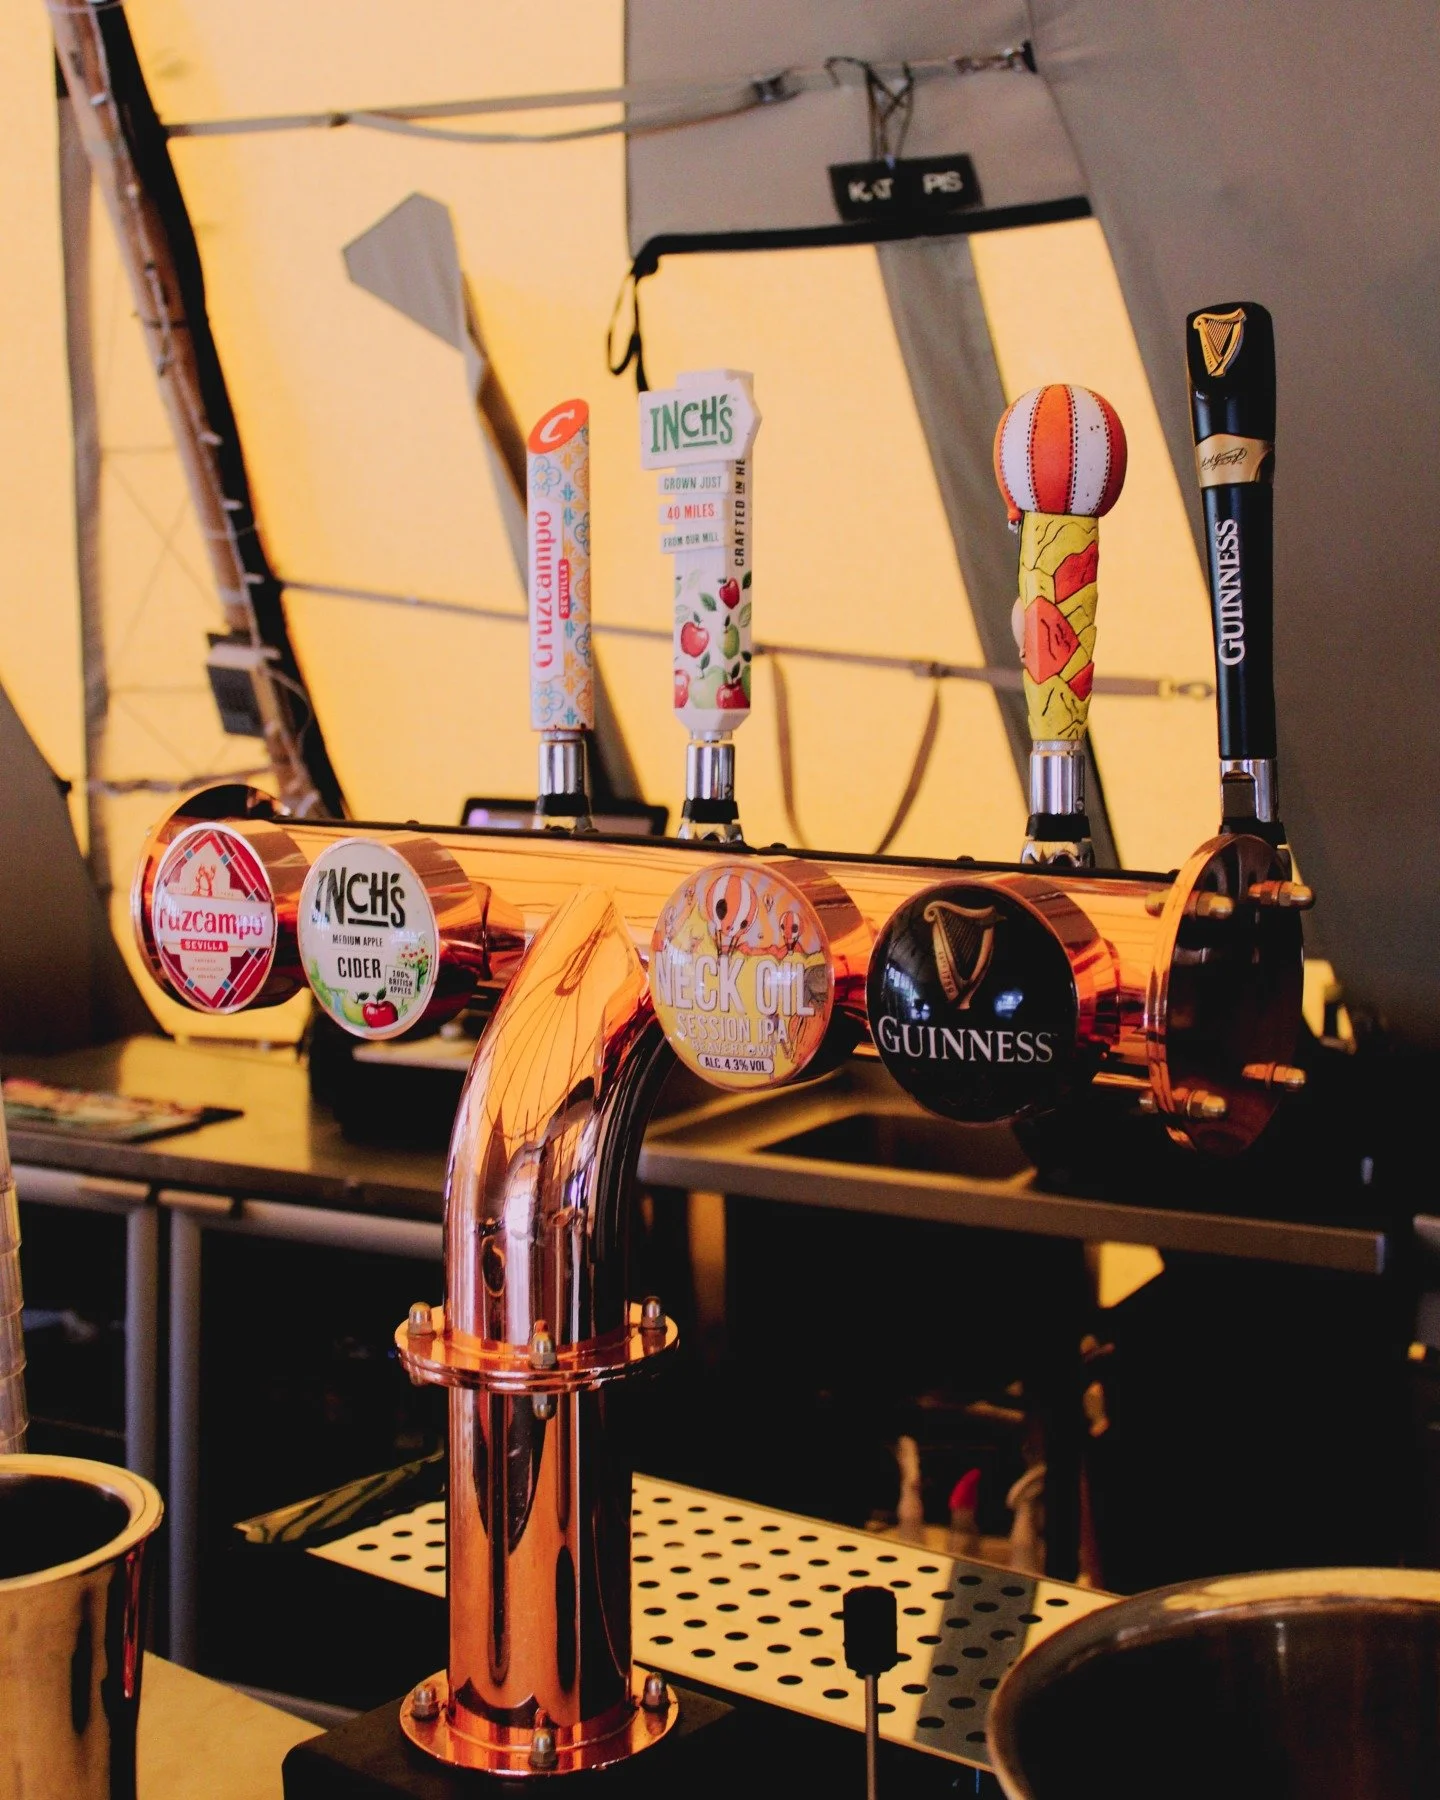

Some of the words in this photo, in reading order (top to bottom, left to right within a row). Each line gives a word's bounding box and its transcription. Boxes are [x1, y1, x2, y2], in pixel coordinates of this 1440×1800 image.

[540, 409, 575, 443] C
[664, 477, 697, 490] GROWN
[700, 475, 722, 489] JUST
[735, 483, 745, 494] IN
[667, 506, 681, 520] 40
[684, 503, 715, 518] MILES
[664, 537, 683, 548] FROM
[686, 534, 700, 545] OUR
[702, 532, 720, 544] MILL
[735, 503, 745, 566] CRAFTED
[533, 511, 557, 668] Cruzcampo
[560, 564, 569, 613] SEVILLA
[1214, 518, 1245, 666] GUINNESS
[184, 939, 224, 950] SEVILLA
[332, 934, 361, 946] MEDIUM
[363, 935, 384, 948] APPLE
[338, 957, 382, 979] CIDER
[392, 969, 410, 980] 100%
[388, 977, 413, 988] BRITISH
[389, 984, 413, 995] APPLES
[656, 952, 747, 1015] NECK
[756, 959, 815, 1017] OIL
[676, 1012, 751, 1043] SESSION
[758, 1018, 790, 1044] IPA
[878, 1015, 1054, 1064] GUINNESS
[750, 1060, 768, 1072] VOL
